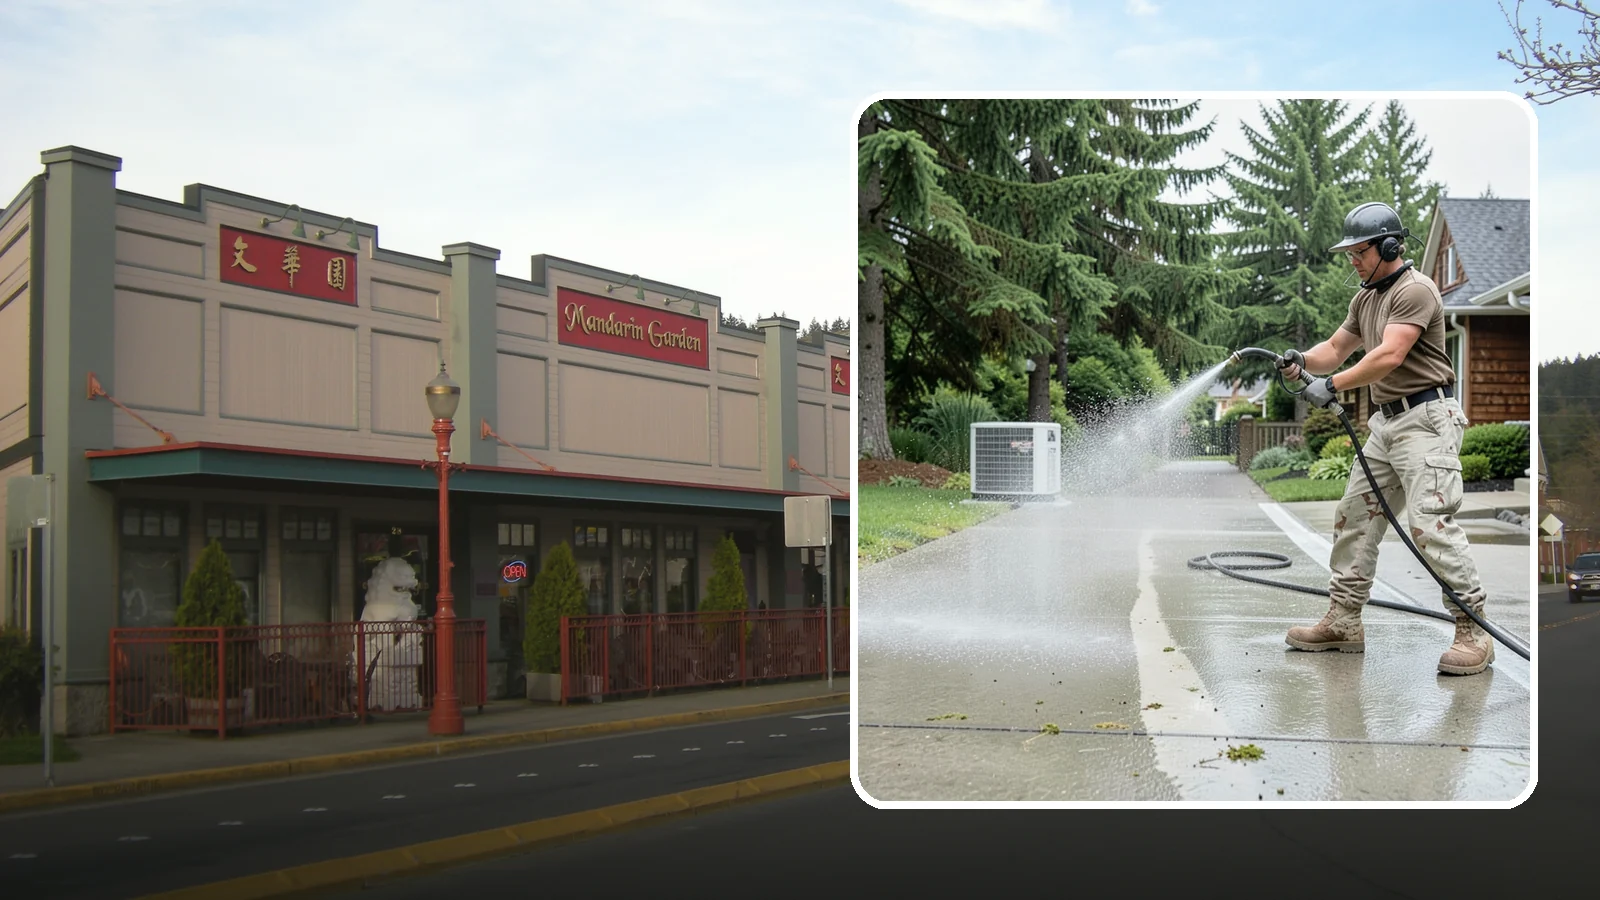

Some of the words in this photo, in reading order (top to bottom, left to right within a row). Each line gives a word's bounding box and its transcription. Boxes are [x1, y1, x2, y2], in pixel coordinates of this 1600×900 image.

[231, 235, 346, 291] 文華園
[564, 302, 644, 341] Mandarin
[648, 320, 701, 352] Garden
[503, 565, 527, 578] OPEN
